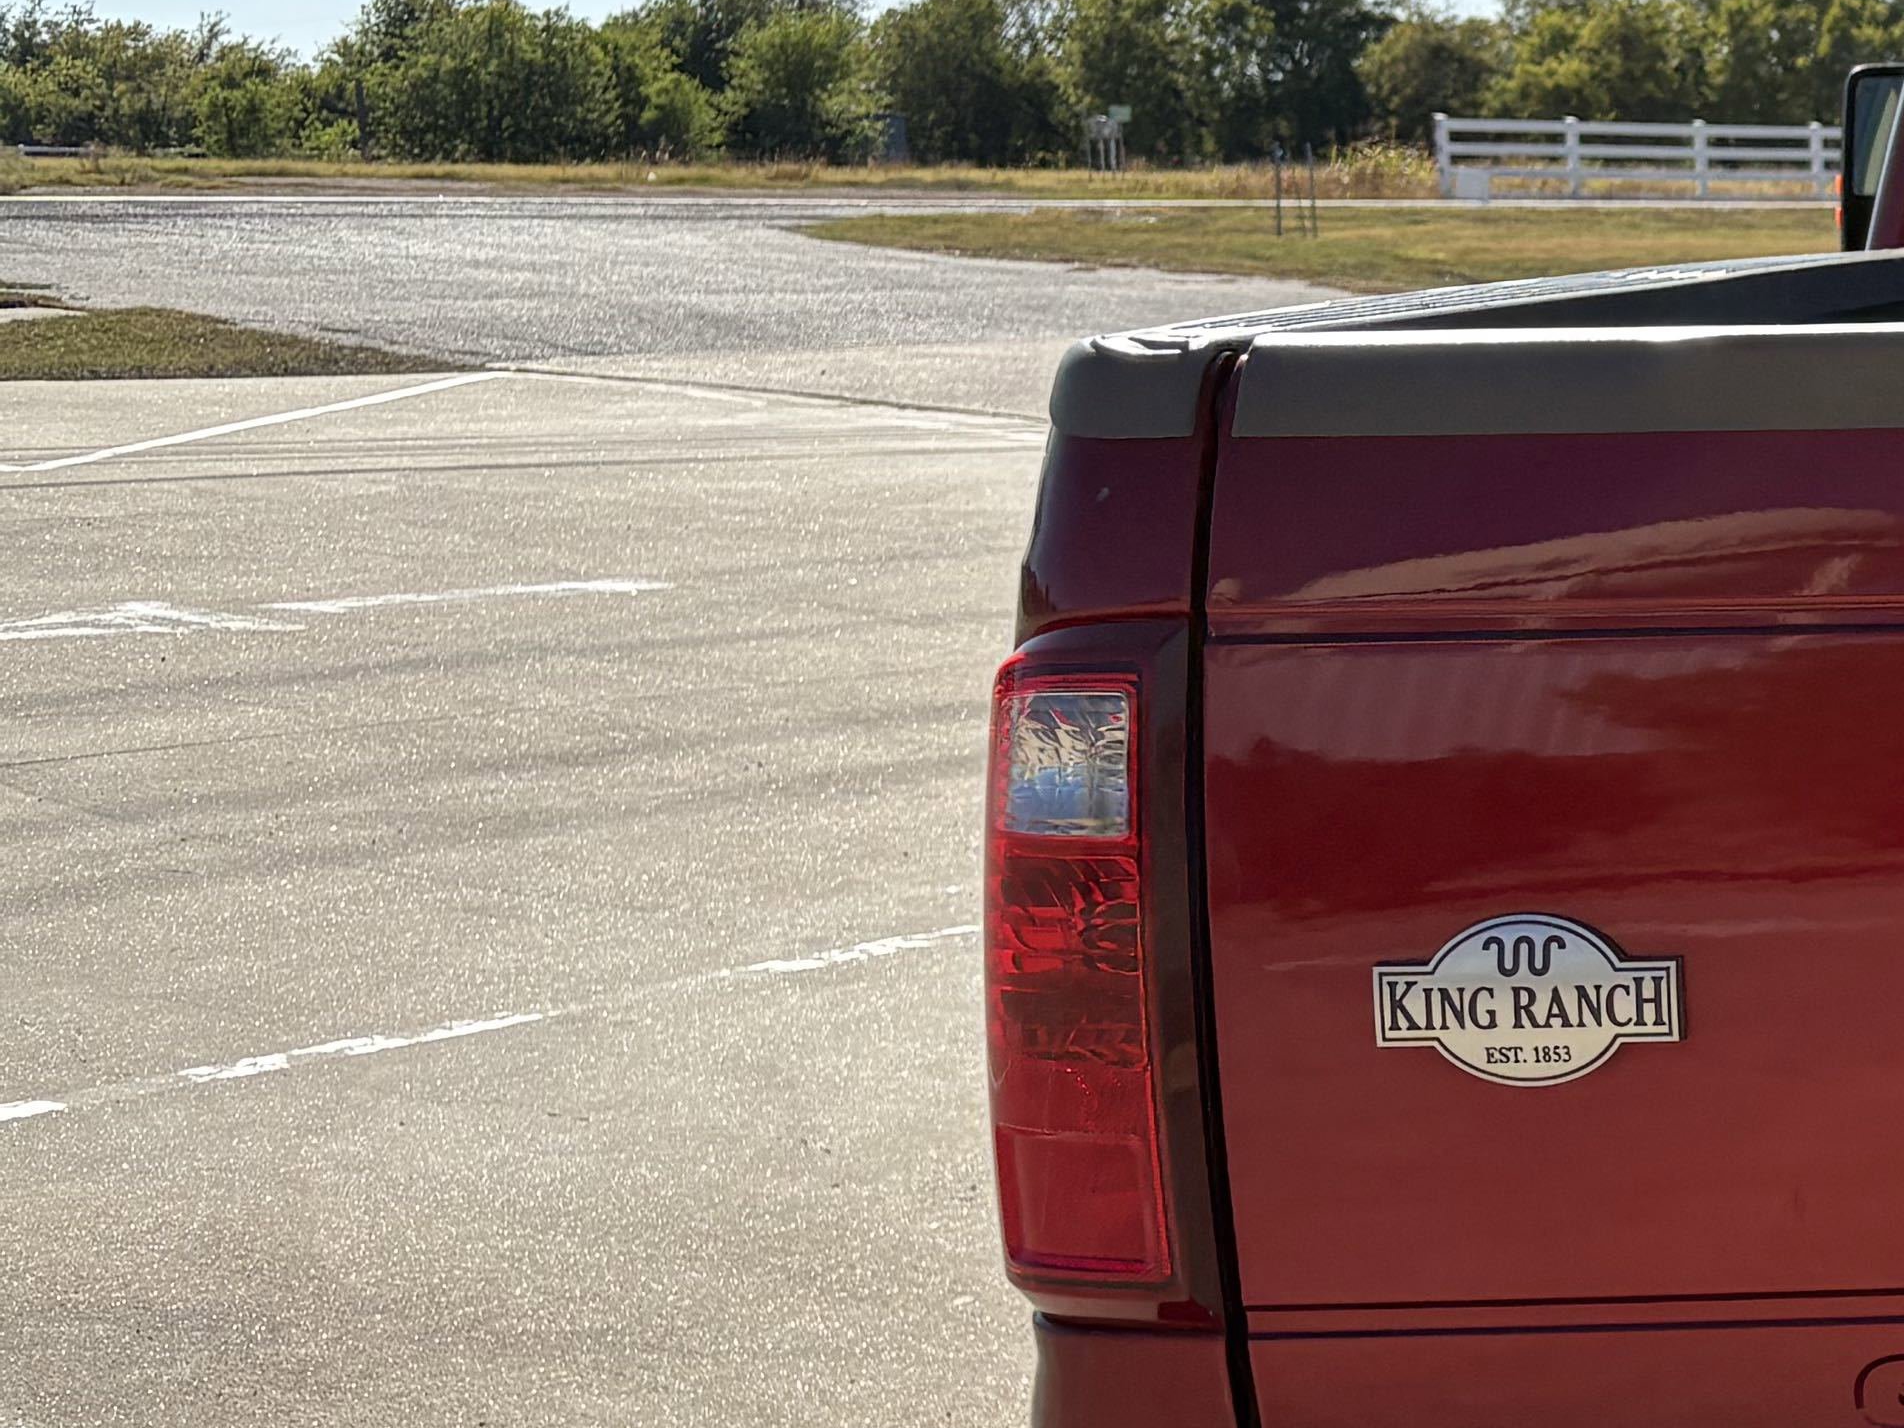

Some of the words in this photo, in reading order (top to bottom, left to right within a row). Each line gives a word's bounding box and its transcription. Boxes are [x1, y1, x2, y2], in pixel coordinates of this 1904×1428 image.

[1386, 980, 1498, 1031] KING
[1511, 976, 1667, 1029] RANCH
[1485, 1046, 1527, 1064] EST.
[1534, 1045, 1572, 1063] 1853
